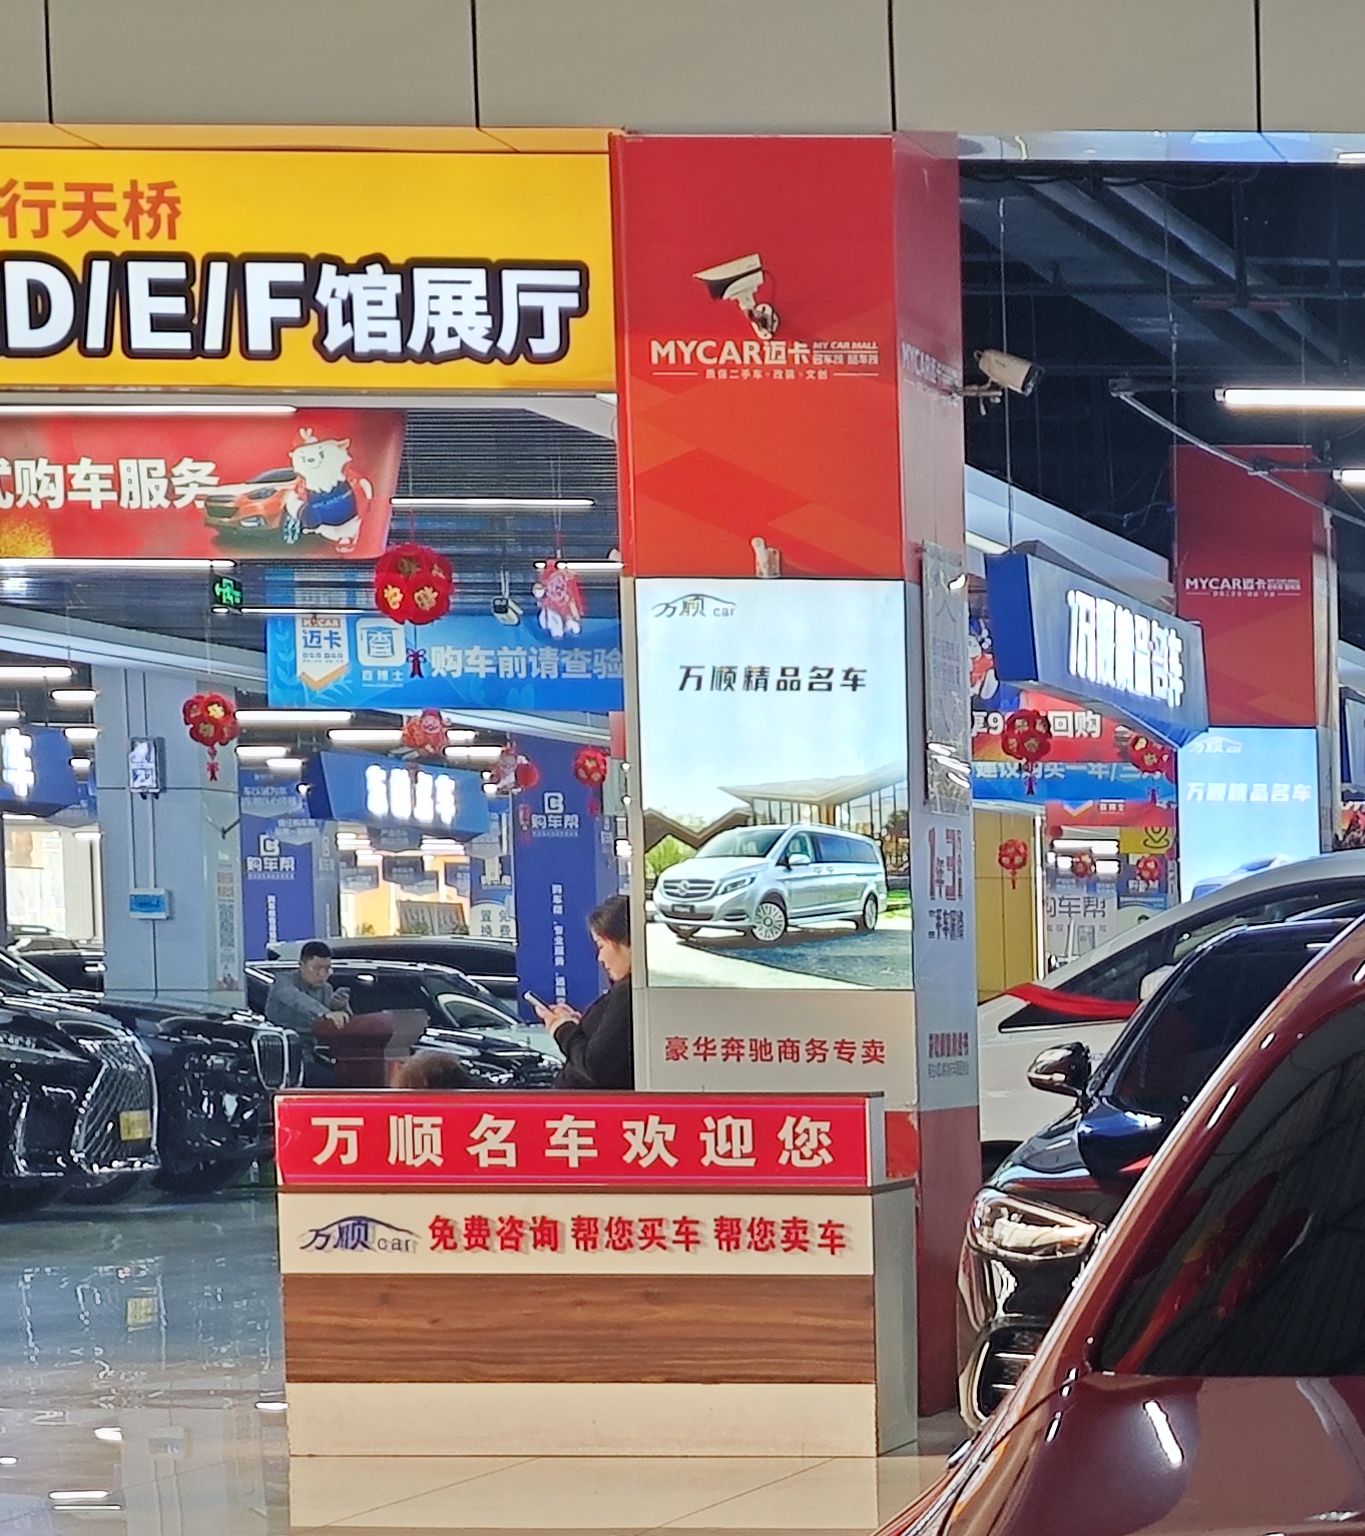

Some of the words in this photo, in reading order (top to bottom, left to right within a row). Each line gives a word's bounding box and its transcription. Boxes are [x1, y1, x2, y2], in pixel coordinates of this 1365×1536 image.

[0, 178, 182, 241] 行天桥
[713, 605, 736, 617] car
[430, 646, 624, 679] 购车前请查验
[679, 665, 867, 692] 万顺精品名车
[531, 814, 579, 829] 购车帮
[246, 857, 296, 872] 购车帮
[664, 1036, 886, 1063] 豪华奔驰商务专卖
[310, 1115, 834, 1168] 万顺名车欢迎您
[428, 1215, 560, 1252] 免费咨询
[571, 1215, 701, 1252] 帮您买车
[713, 1216, 846, 1256] 帮您卖车
